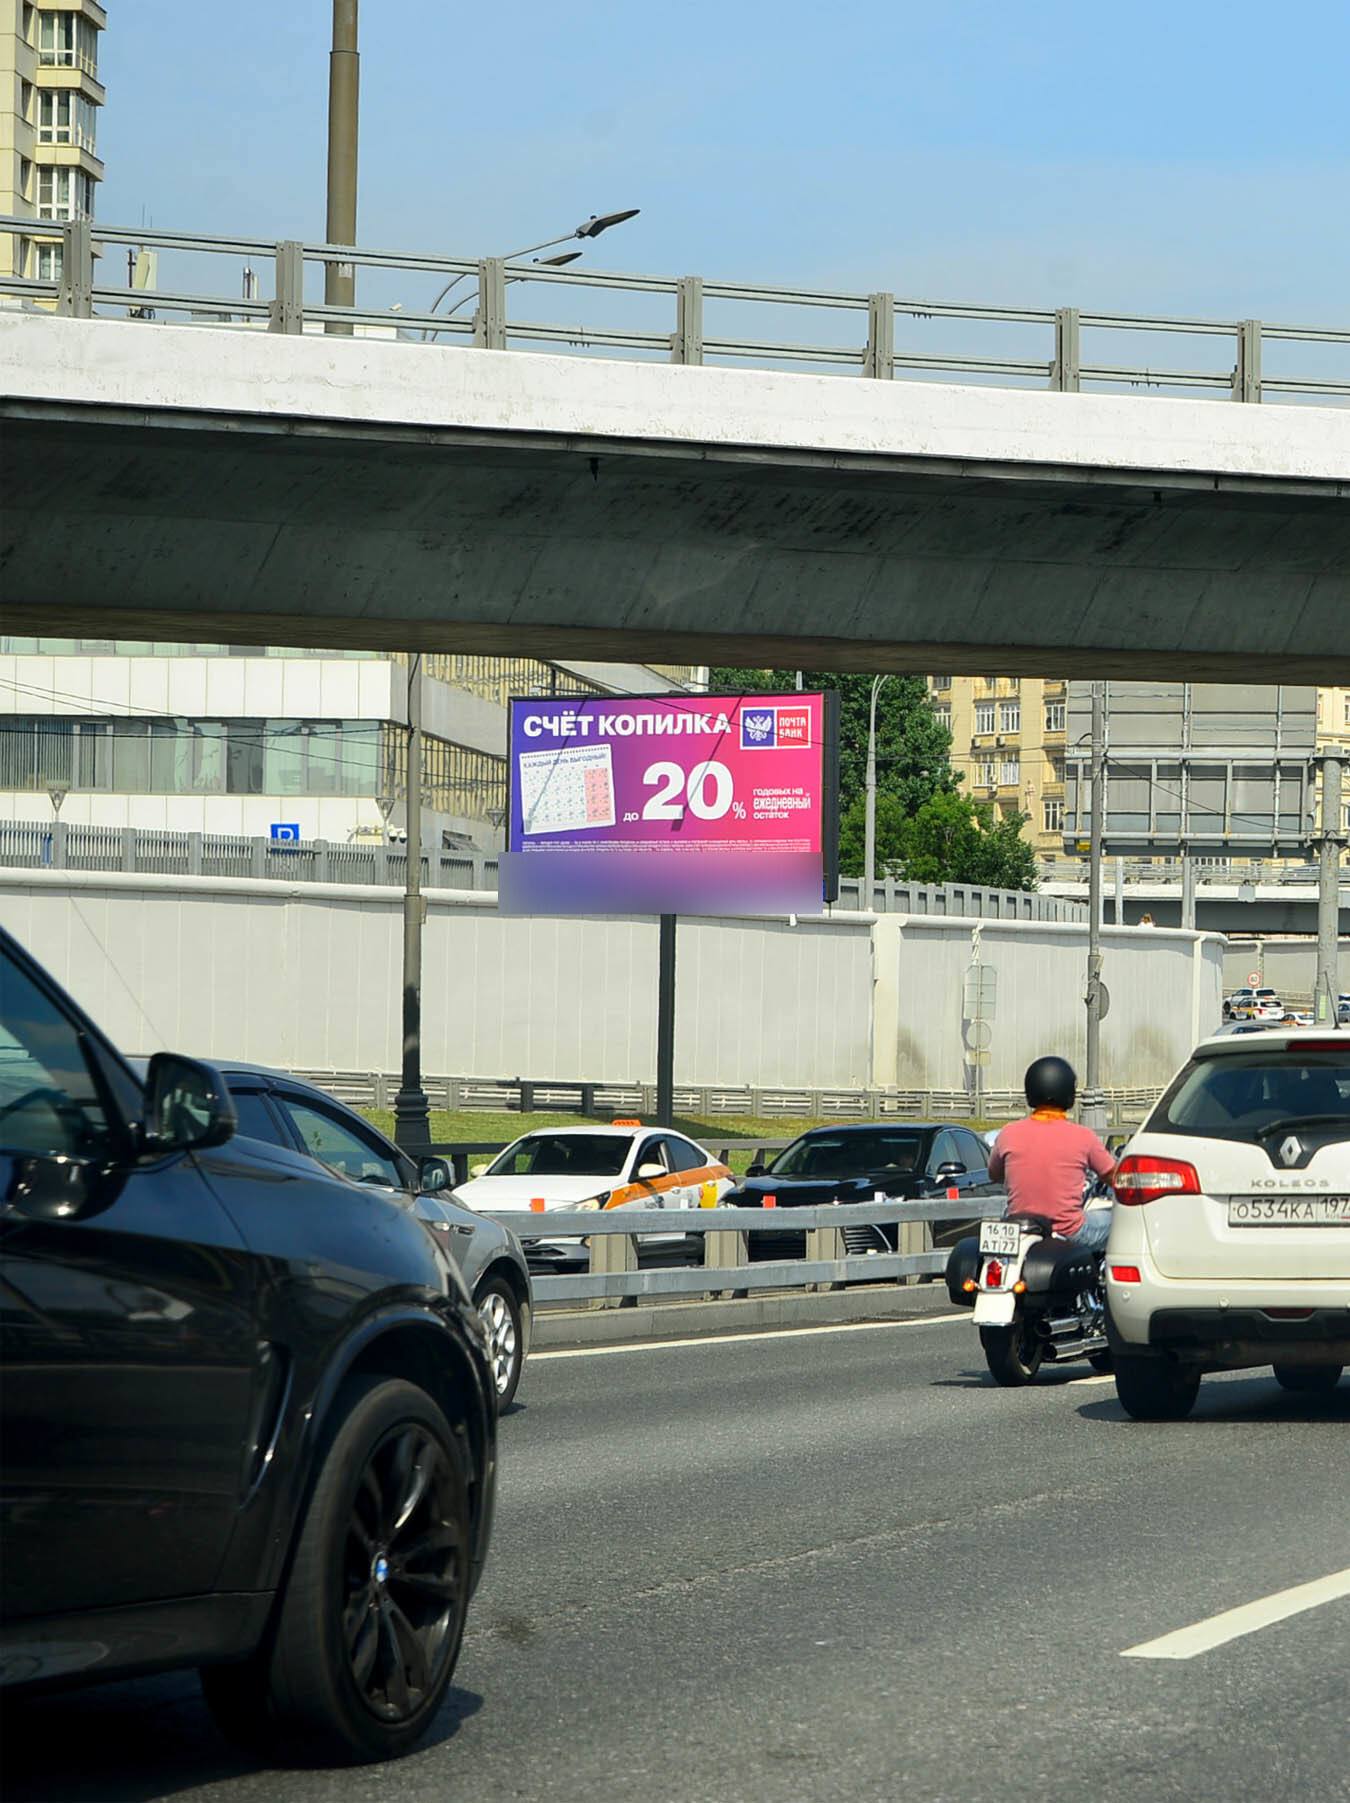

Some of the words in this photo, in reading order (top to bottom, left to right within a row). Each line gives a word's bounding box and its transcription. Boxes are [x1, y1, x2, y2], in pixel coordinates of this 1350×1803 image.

[523, 710, 594, 737] СЧЁТ
[599, 712, 732, 736] КОПИЛКА
[779, 717, 806, 728] ПОЧТА
[779, 728, 803, 738] БАНК
[753, 788, 791, 796] годовых
[792, 787, 804, 795] на
[753, 793, 811, 810] ежедневный
[623, 813, 640, 822] до
[753, 811, 790, 820] остаток
[1251, 1179, 1330, 1188] KOLEOS
